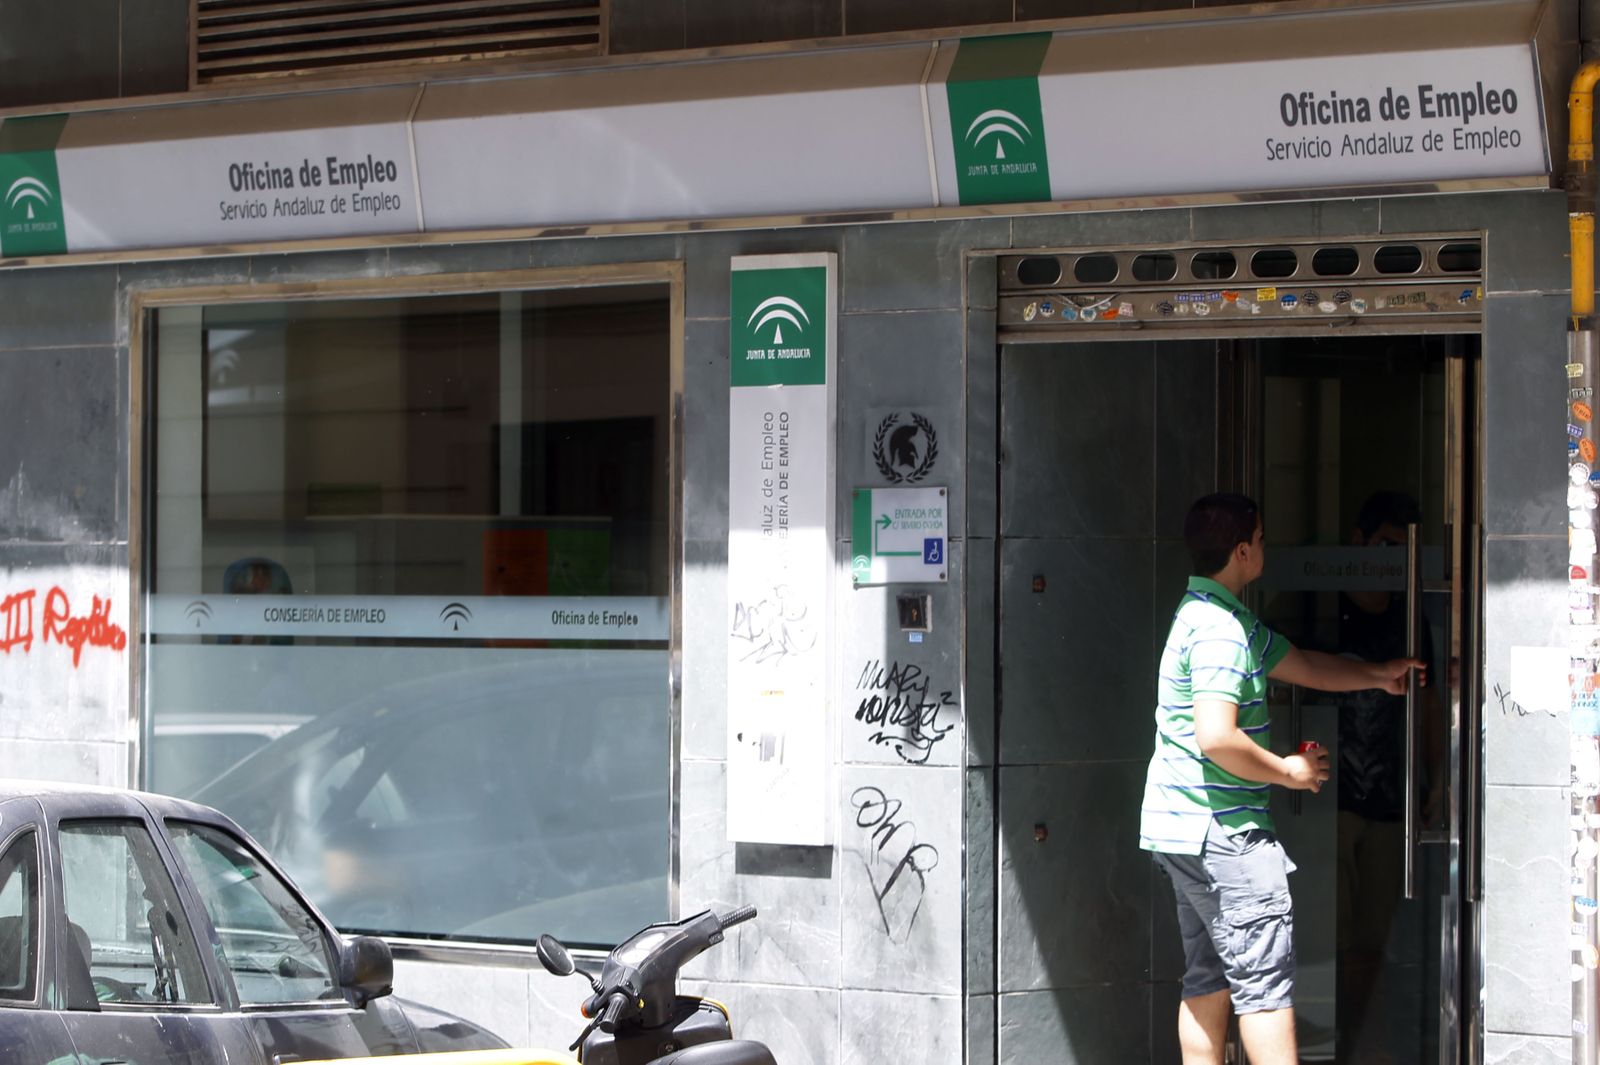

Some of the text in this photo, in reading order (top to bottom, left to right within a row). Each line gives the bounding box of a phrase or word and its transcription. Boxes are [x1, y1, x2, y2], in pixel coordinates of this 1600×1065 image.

[1280, 81, 1518, 127] Oficina de Empleo
[1265, 126, 1521, 161] Servicio Andaluz de Empleo
[228, 154, 397, 192] Oficina de Empleo
[968, 164, 989, 177] JUNTA
[990, 164, 999, 175] DE
[219, 191, 401, 221] Servicio Andaluz de Empleo
[746, 349, 766, 360] JUNTA
[767, 349, 776, 360] DE
[761, 411, 776, 470] Empleo
[779, 411, 789, 467] EMPLEO
[761, 478, 773, 498] de
[779, 472, 788, 490] DE
[894, 508, 943, 519] ENTRADA POR
[1303, 561, 1403, 580] Oficina de Empleo
[264, 605, 386, 624] CONSEJERÍA DE EMPLEO
[551, 611, 639, 629] Oficina de Empleo
